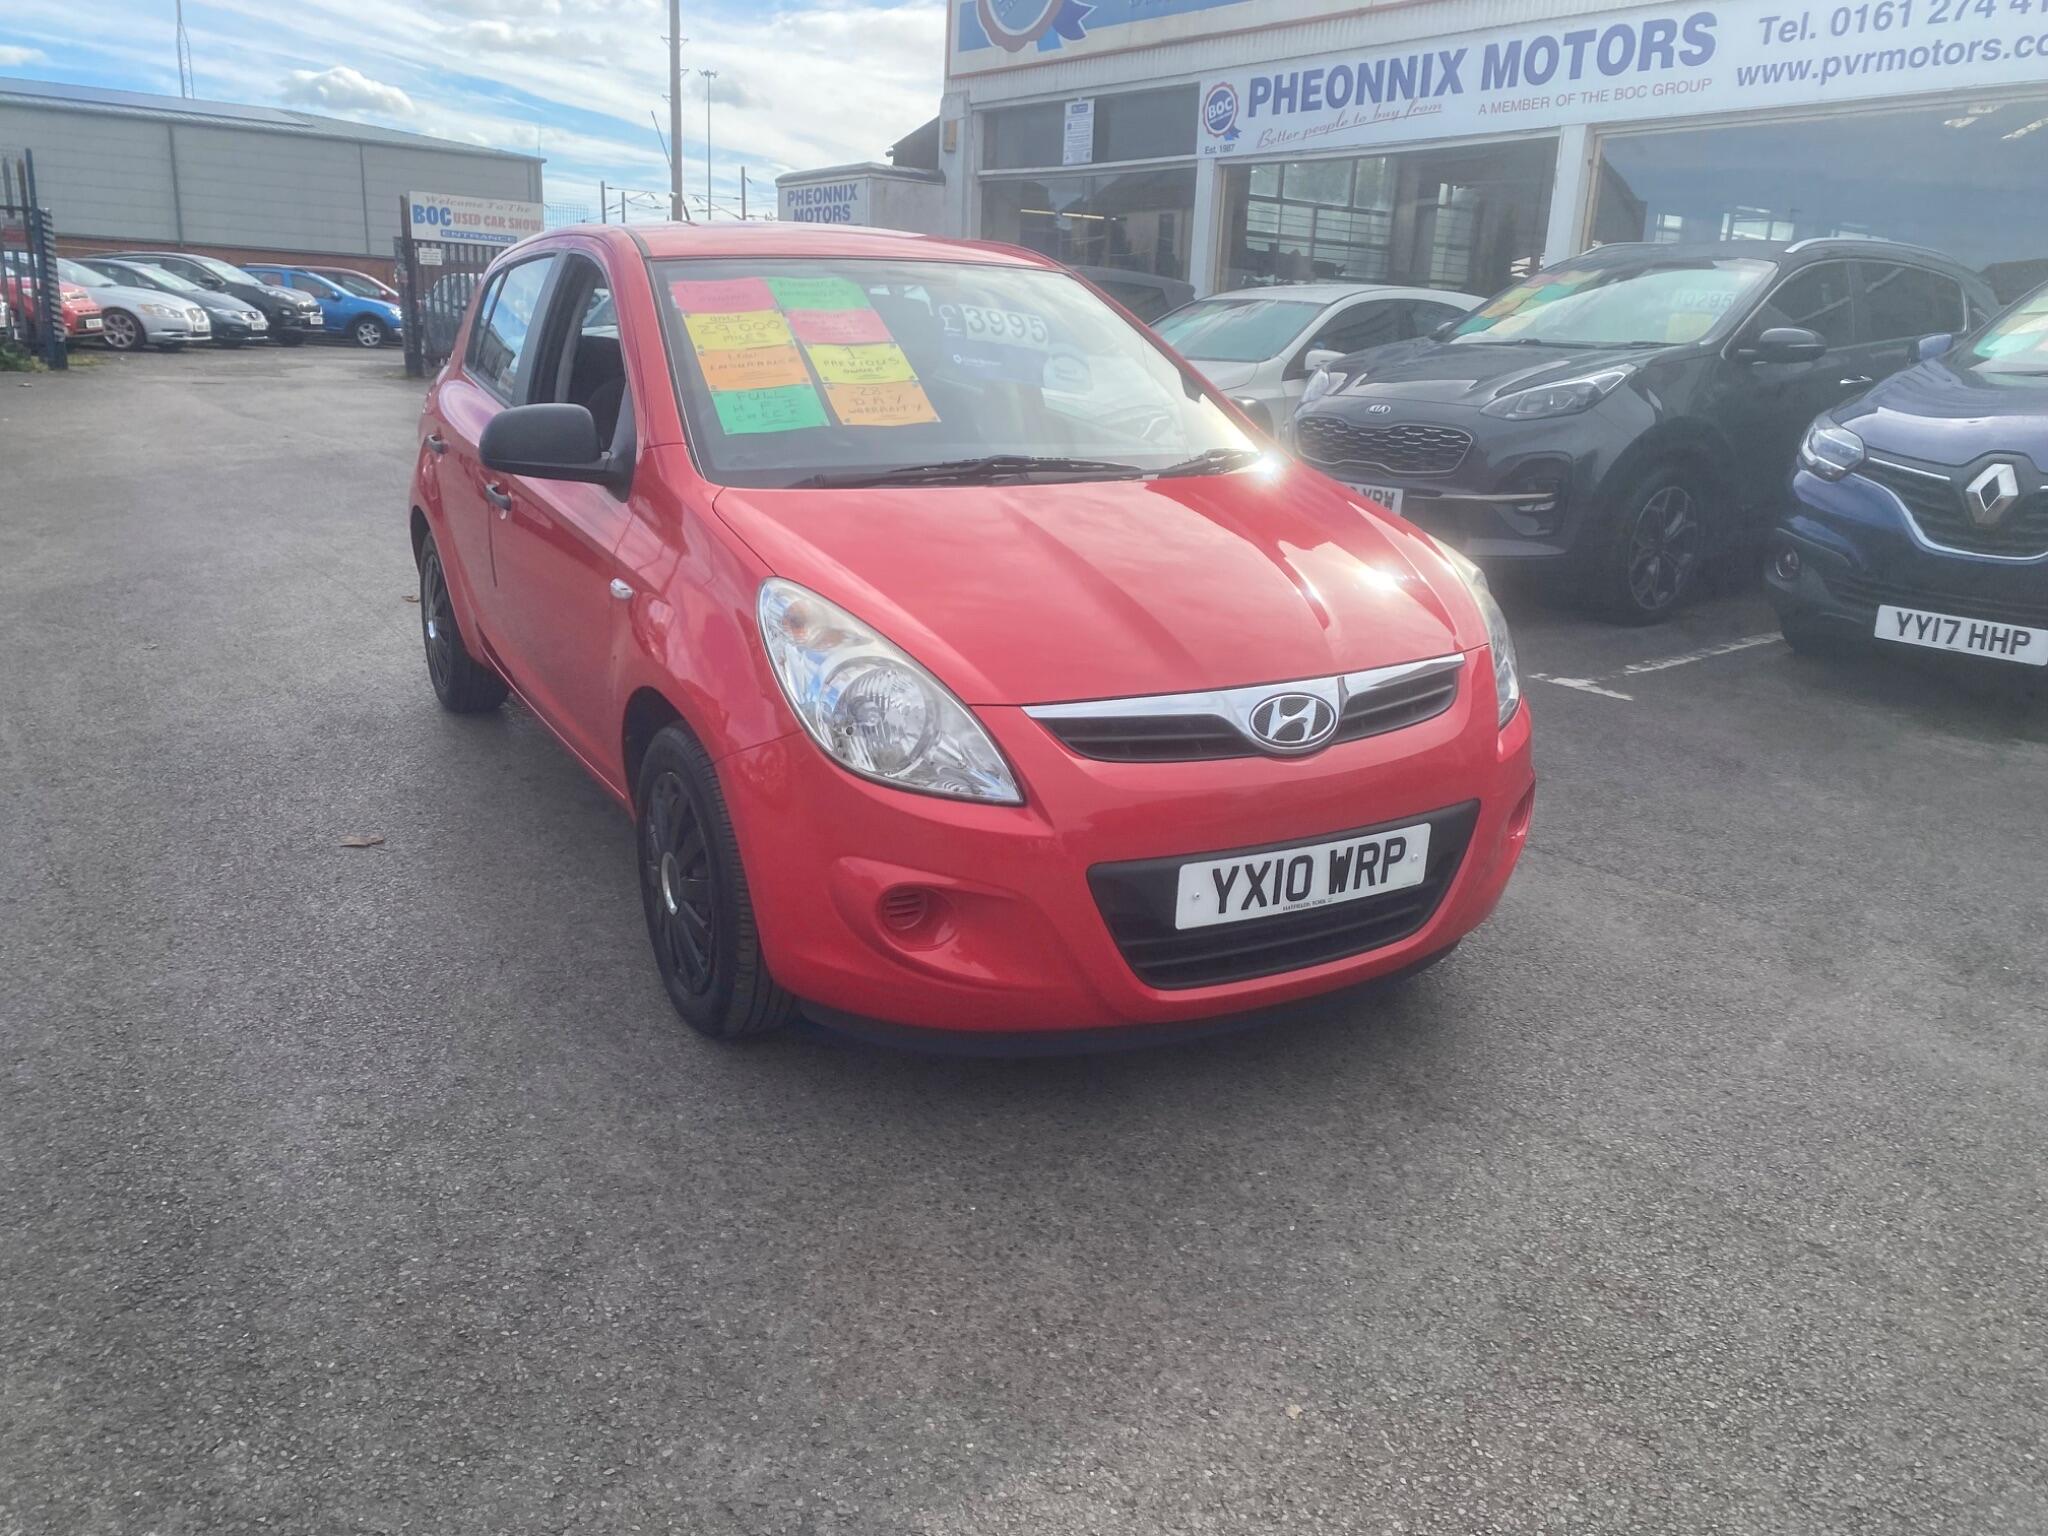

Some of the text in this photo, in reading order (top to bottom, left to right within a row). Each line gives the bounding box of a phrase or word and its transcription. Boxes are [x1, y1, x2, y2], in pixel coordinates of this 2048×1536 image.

[1758, 11, 1816, 46] Tel.
[1830, 0, 1912, 37] 0161
[1248, 11, 1718, 118] PHEONNIX MOTORS
[1208, 96, 1233, 119] BOC
[1478, 78, 1713, 115] A MEMBER OF THE BOC GROUP
[1256, 98, 1442, 149] Better people to buy from
[426, 195, 484, 209] Welcome
[507, 203, 530, 213] The
[787, 184, 858, 207] PHEONNIX
[412, 204, 452, 226] BOC
[453, 211, 482, 227] USED
[484, 215, 506, 229] CAR
[793, 204, 851, 224] MOTORS
[442, 230, 515, 243] ENTRANCE
[823, 356, 900, 368] PREVIOUS
[1367, 404, 1391, 414] KIA
[1896, 611, 2031, 655] YY17 HHP
[1212, 836, 1407, 914] YX10 WRP
